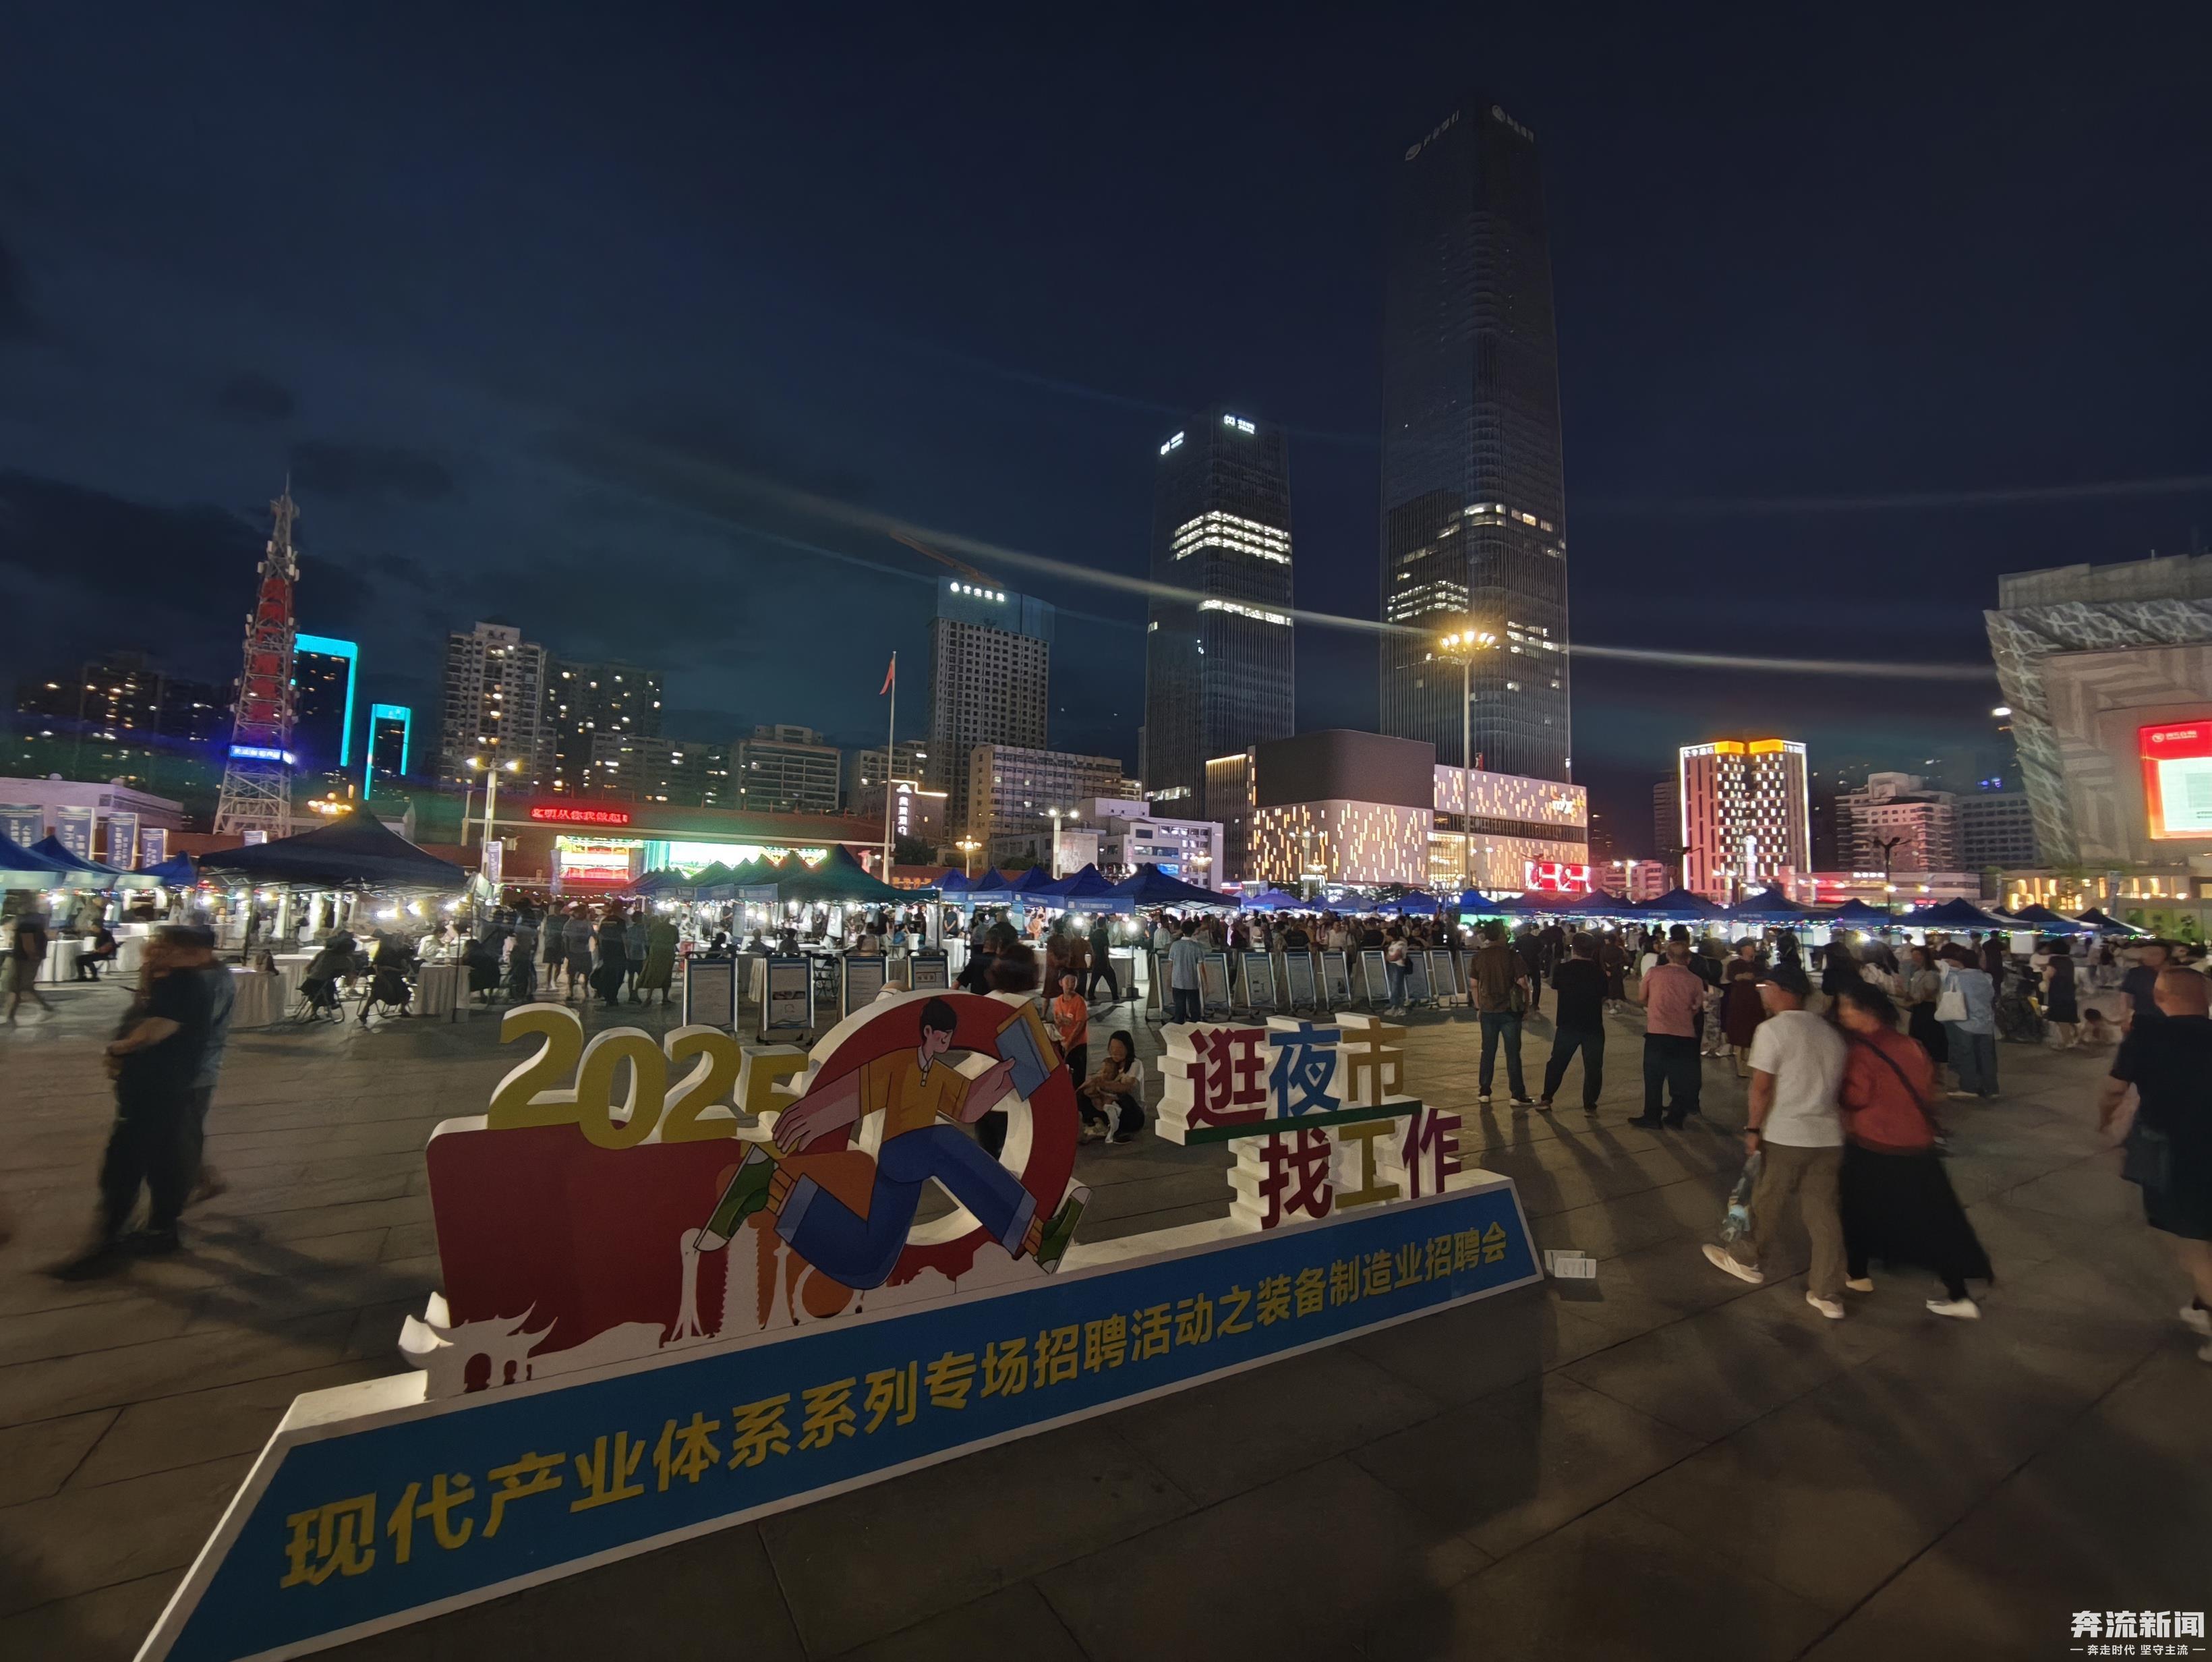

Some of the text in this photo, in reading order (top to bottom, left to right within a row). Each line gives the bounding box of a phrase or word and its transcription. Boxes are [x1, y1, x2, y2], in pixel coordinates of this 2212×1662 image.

[488, 1008, 809, 1159] 2025
[1185, 1016, 1407, 1130] 逛夜市
[1258, 1108, 1462, 1230] 找工作
[278, 1220, 1508, 1591] 现代产业体系系列专场招聘活动之装备制造业招聘会
